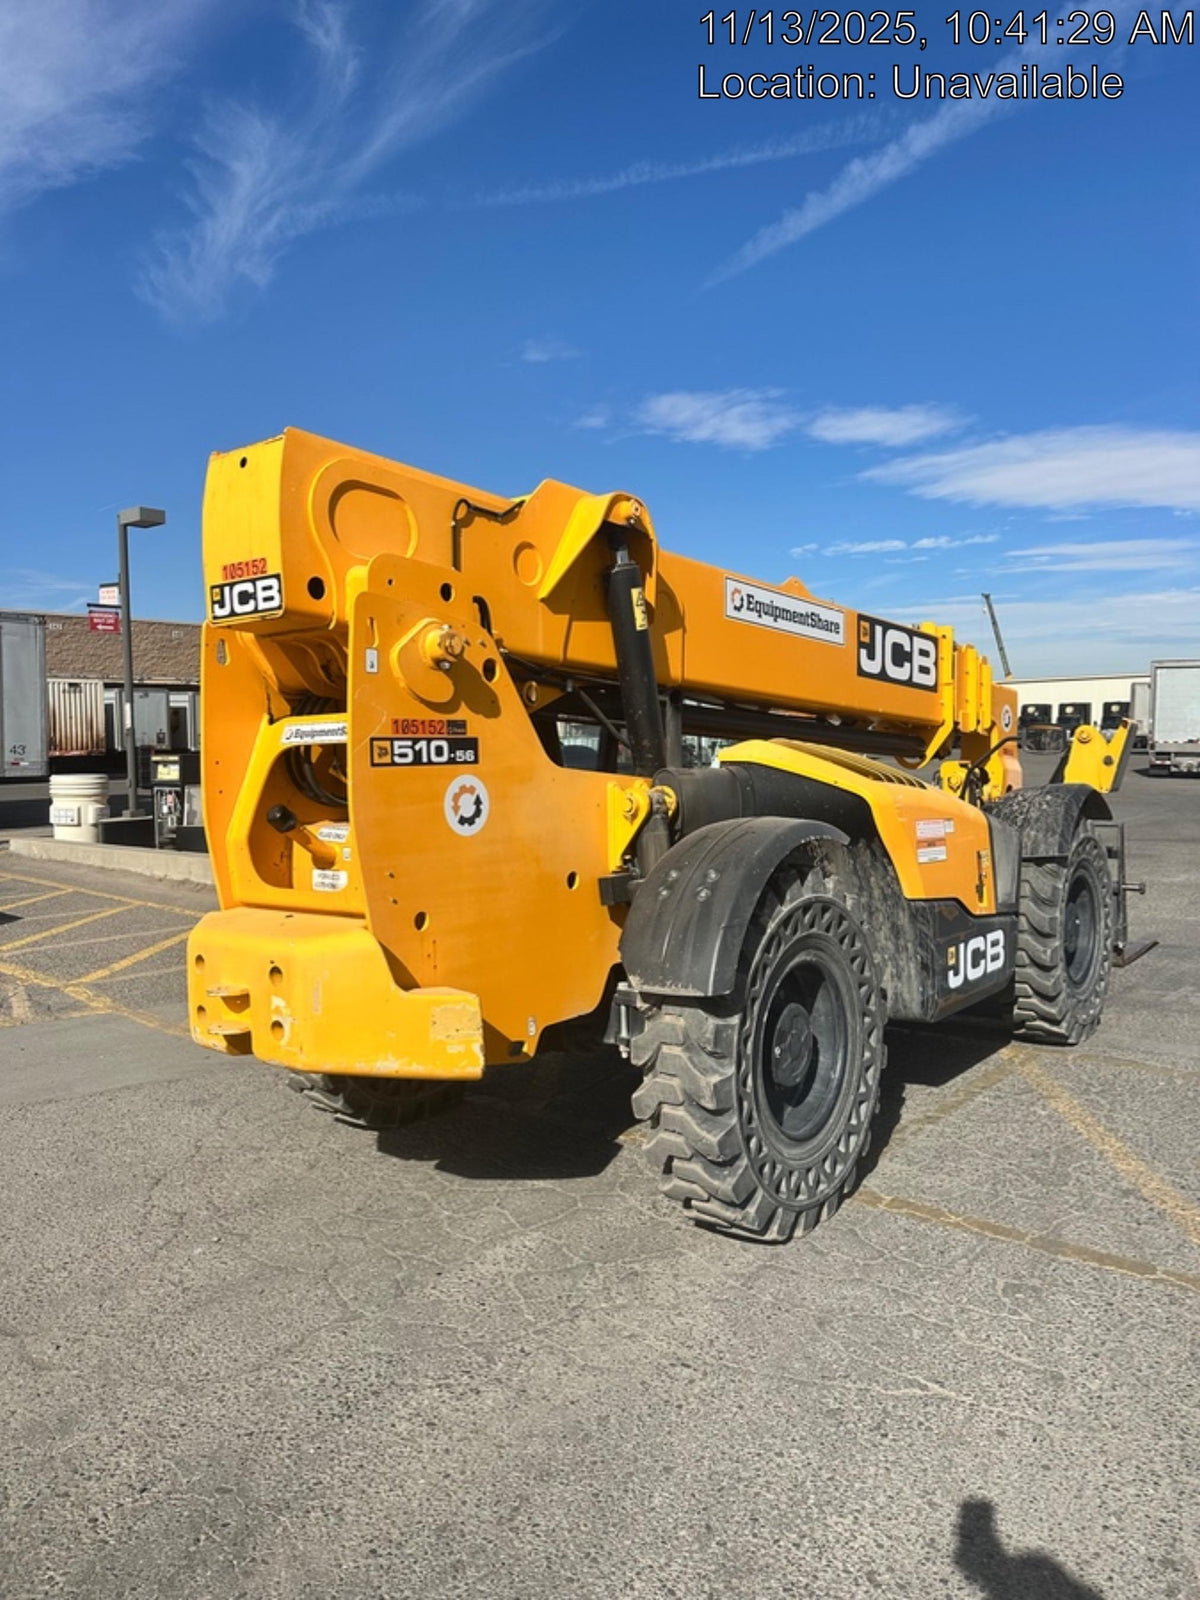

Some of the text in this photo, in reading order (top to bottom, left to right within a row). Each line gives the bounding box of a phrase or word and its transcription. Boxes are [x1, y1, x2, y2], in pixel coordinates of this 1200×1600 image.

[222, 558, 267, 580] 105152
[213, 577, 281, 616] JCB
[746, 594, 840, 634] EquipmentShare
[860, 625, 937, 686] JCB
[392, 719, 445, 735] 105152
[948, 929, 1005, 989] JCB
